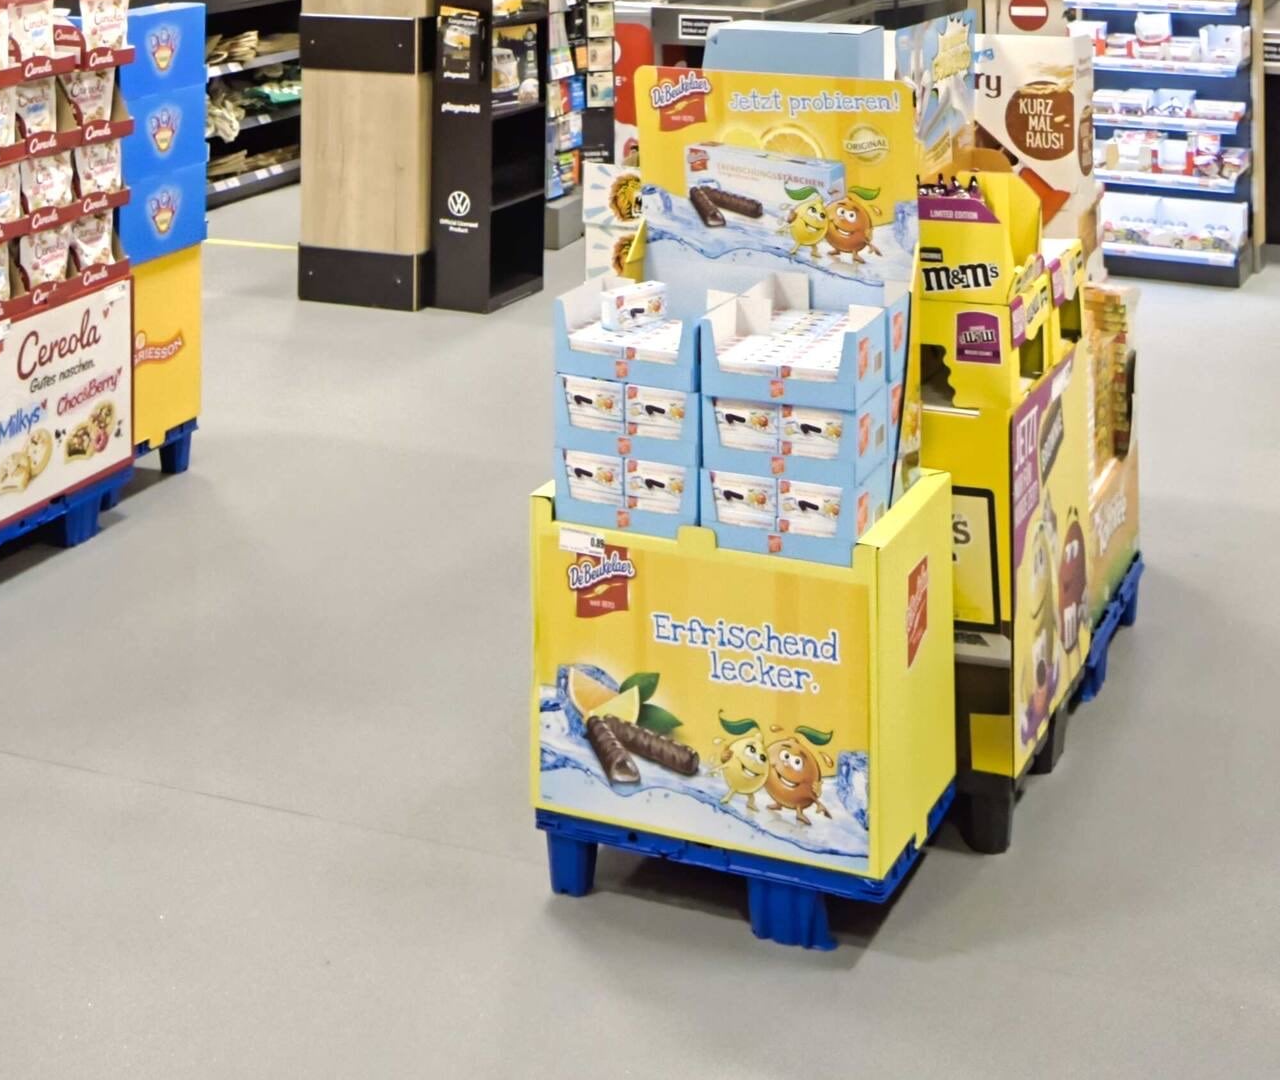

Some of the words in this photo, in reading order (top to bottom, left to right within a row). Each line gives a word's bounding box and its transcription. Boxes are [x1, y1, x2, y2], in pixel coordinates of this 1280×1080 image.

[731, 90, 781, 111] Jetzt
[789, 92, 899, 115] probieren!
[1019, 98, 1053, 115] KURZ
[1029, 115, 1053, 132] MAL
[846, 139, 887, 151] ORIGINAL
[1026, 131, 1064, 149] RAUS!
[930, 210, 953, 219] LIMITED
[954, 211, 978, 220] EDITION
[17, 308, 100, 380] Cereola
[29, 377, 56, 394] Gutes
[652, 612, 840, 663] Erfrischend
[711, 651, 818, 691] lecker.
